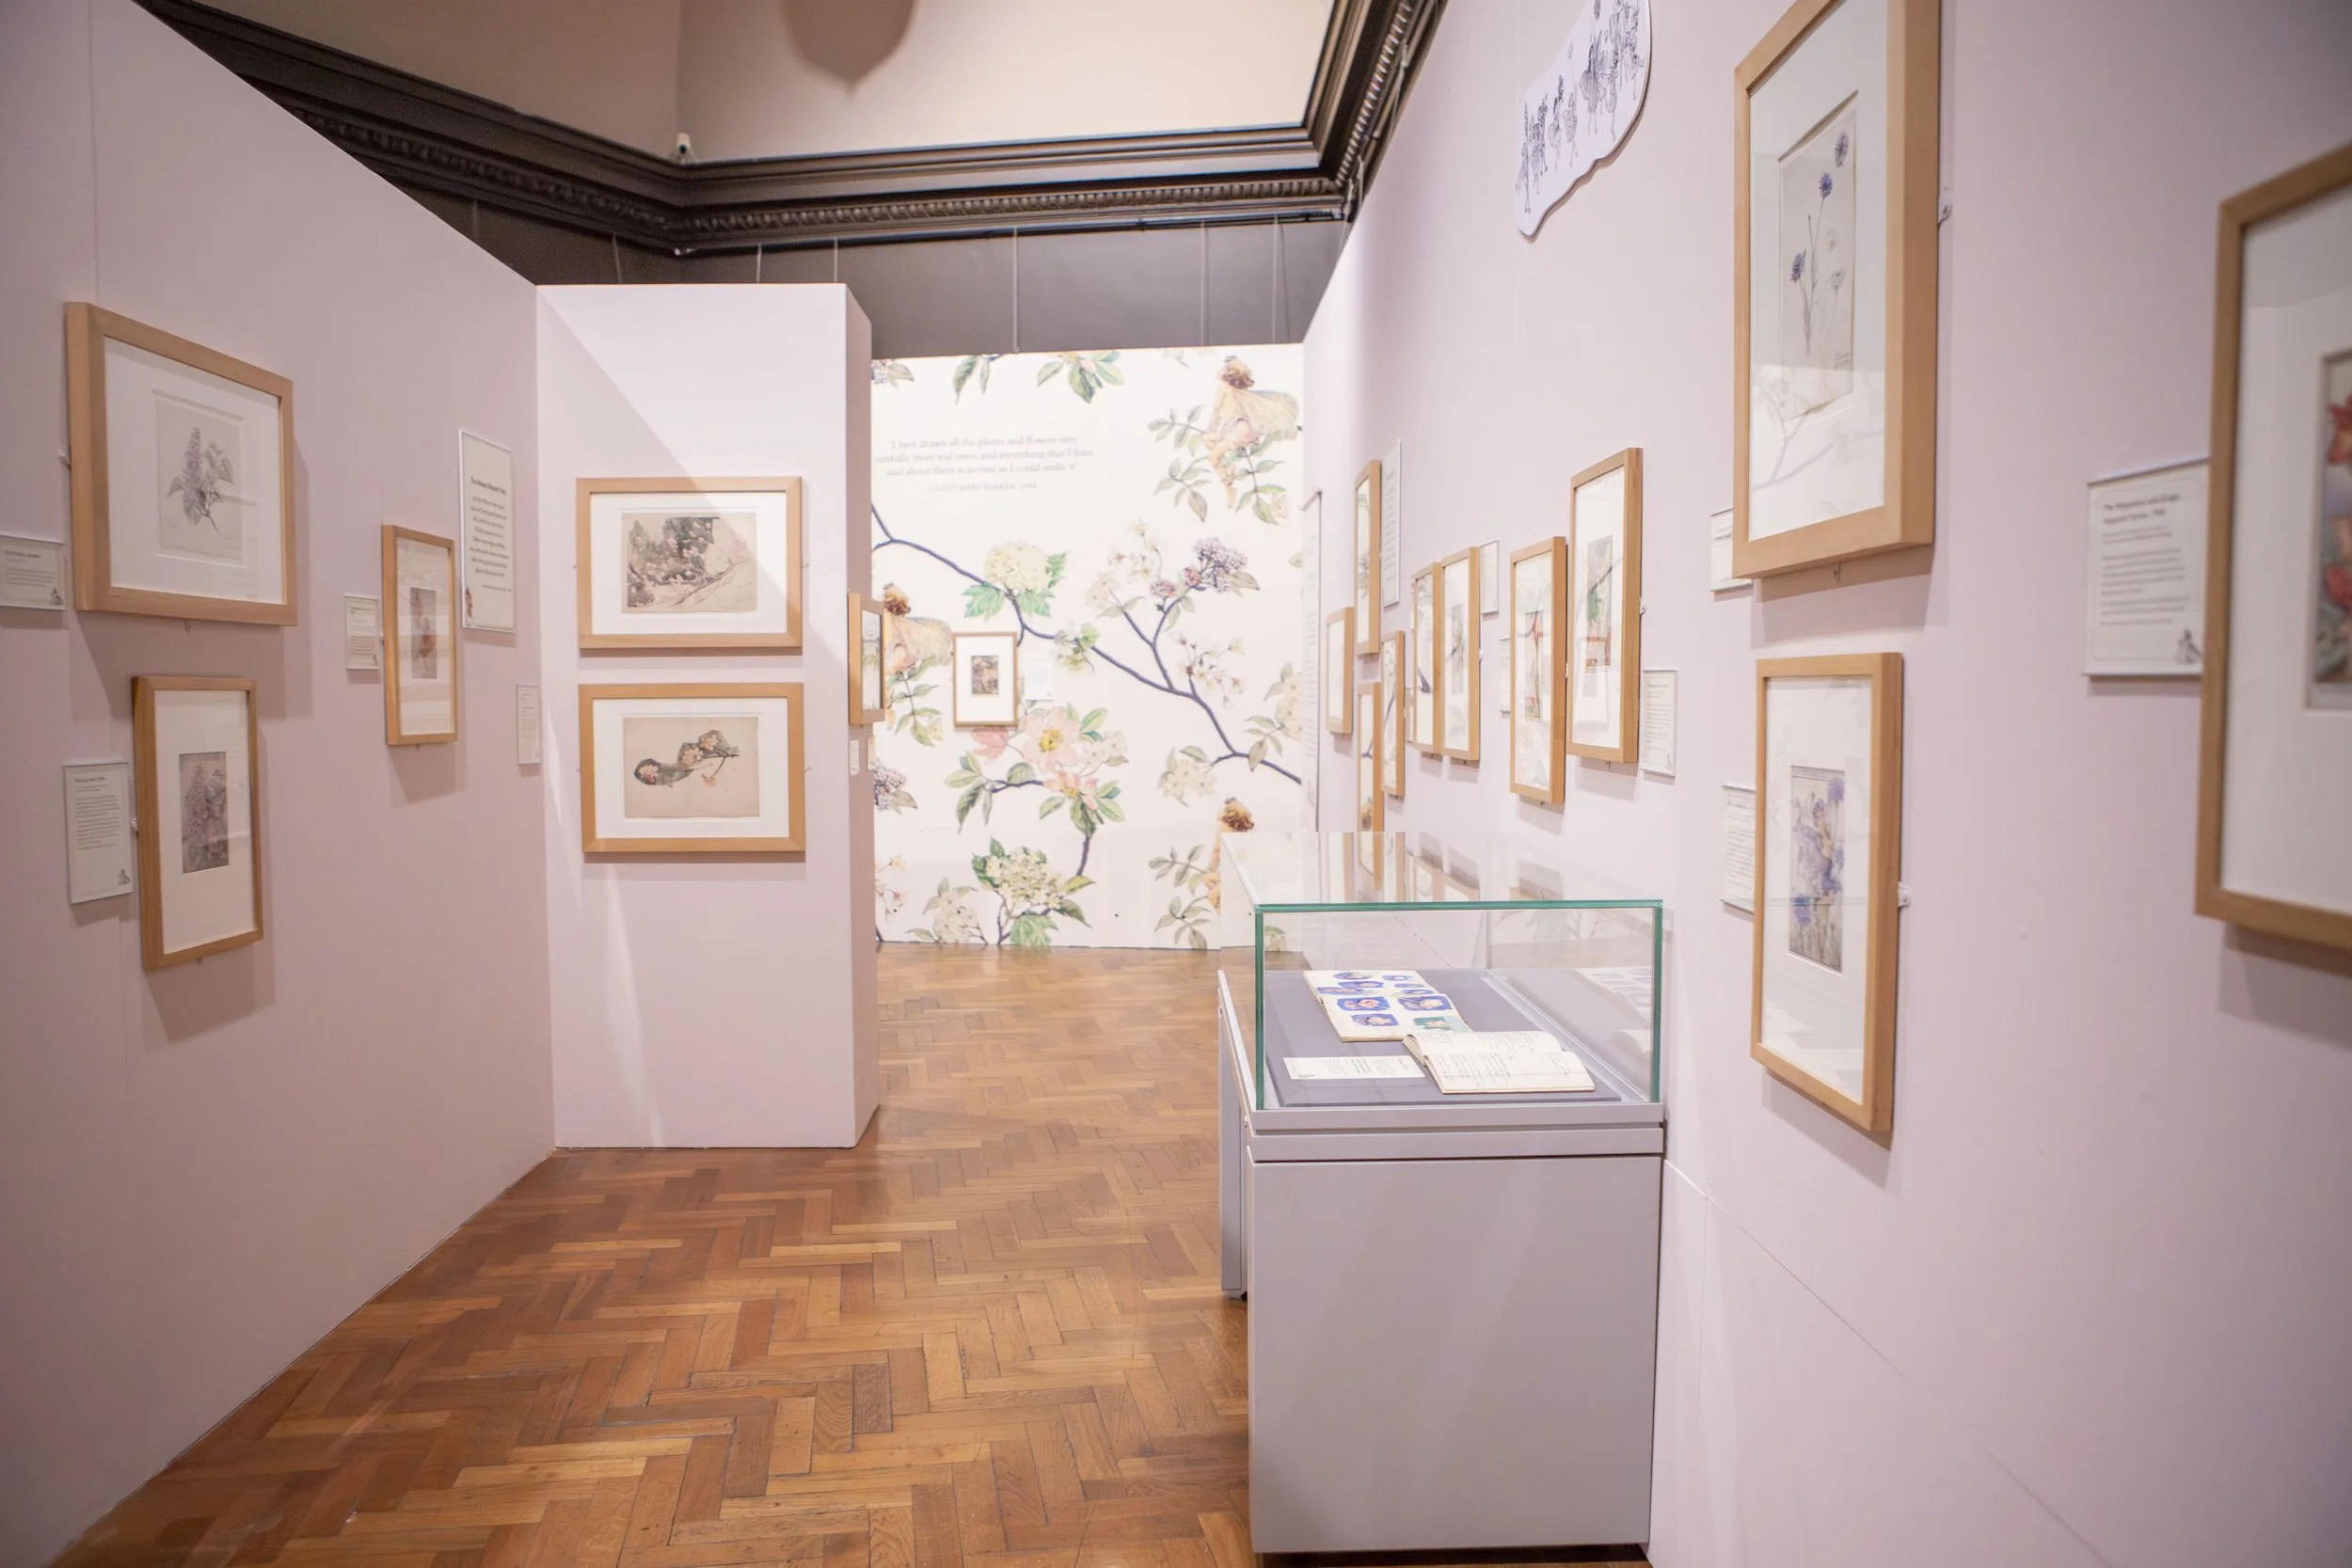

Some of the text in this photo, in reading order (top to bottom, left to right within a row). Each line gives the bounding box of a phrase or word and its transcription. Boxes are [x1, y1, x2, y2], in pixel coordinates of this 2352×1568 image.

[898, 438, 917, 450] have
[919, 436, 947, 449] drawn
[948, 436, 960, 448] all
[961, 435, 975, 447] the
[977, 436, 1005, 449] plants
[1007, 434, 1025, 446] and
[1025, 434, 1057, 446] flowers
[1058, 436, 1077, 447] very
[914, 452, 936, 464] from
[979, 449, 998, 462] and
[999, 446, 1046, 461] everything
[1047, 446, 1065, 459] that
[1073, 446, 1095, 458] have
[885, 465, 904, 478] said
[906, 464, 931, 477] about
[931, 464, 956, 476] them
[1015, 461, 1041, 473] could
[1041, 460, 1067, 473] make
